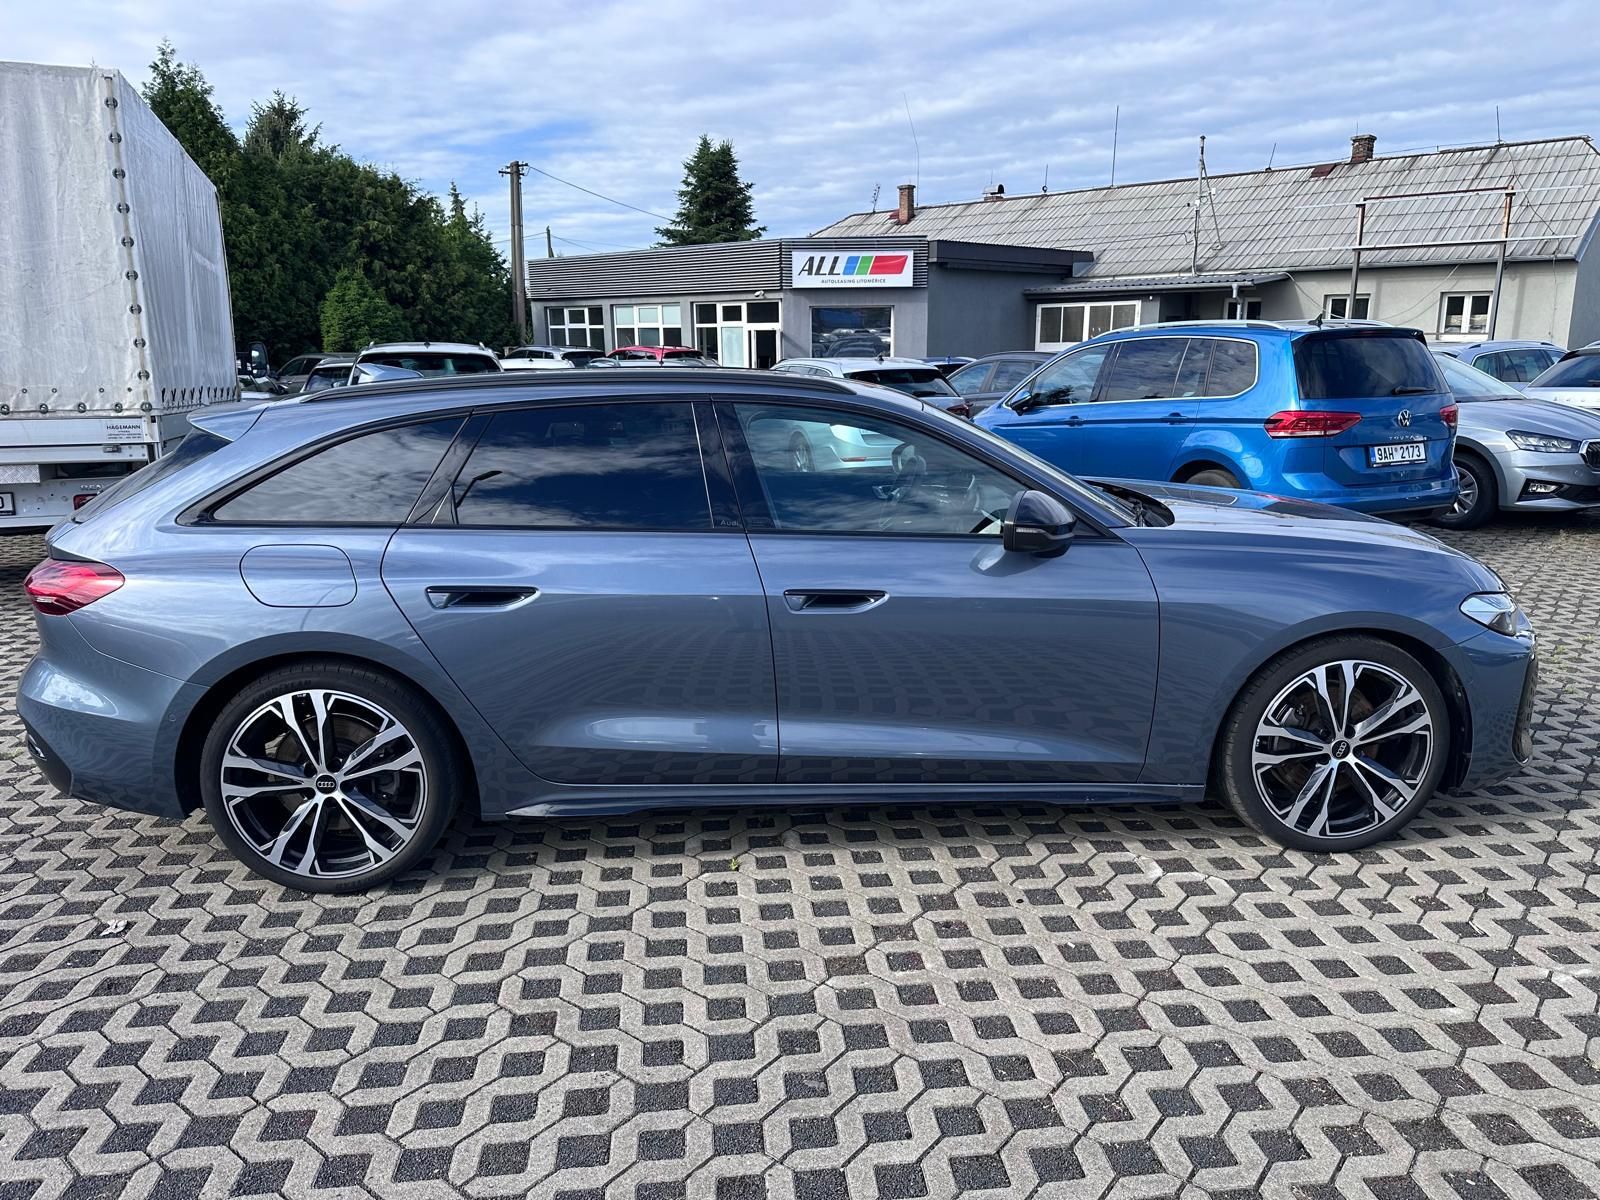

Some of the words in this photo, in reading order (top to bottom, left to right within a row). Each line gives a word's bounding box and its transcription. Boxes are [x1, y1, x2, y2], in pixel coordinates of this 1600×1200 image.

[798, 255, 841, 276] ALL
[1377, 447, 1395, 461] 9AH
[1400, 445, 1421, 459] 2173
